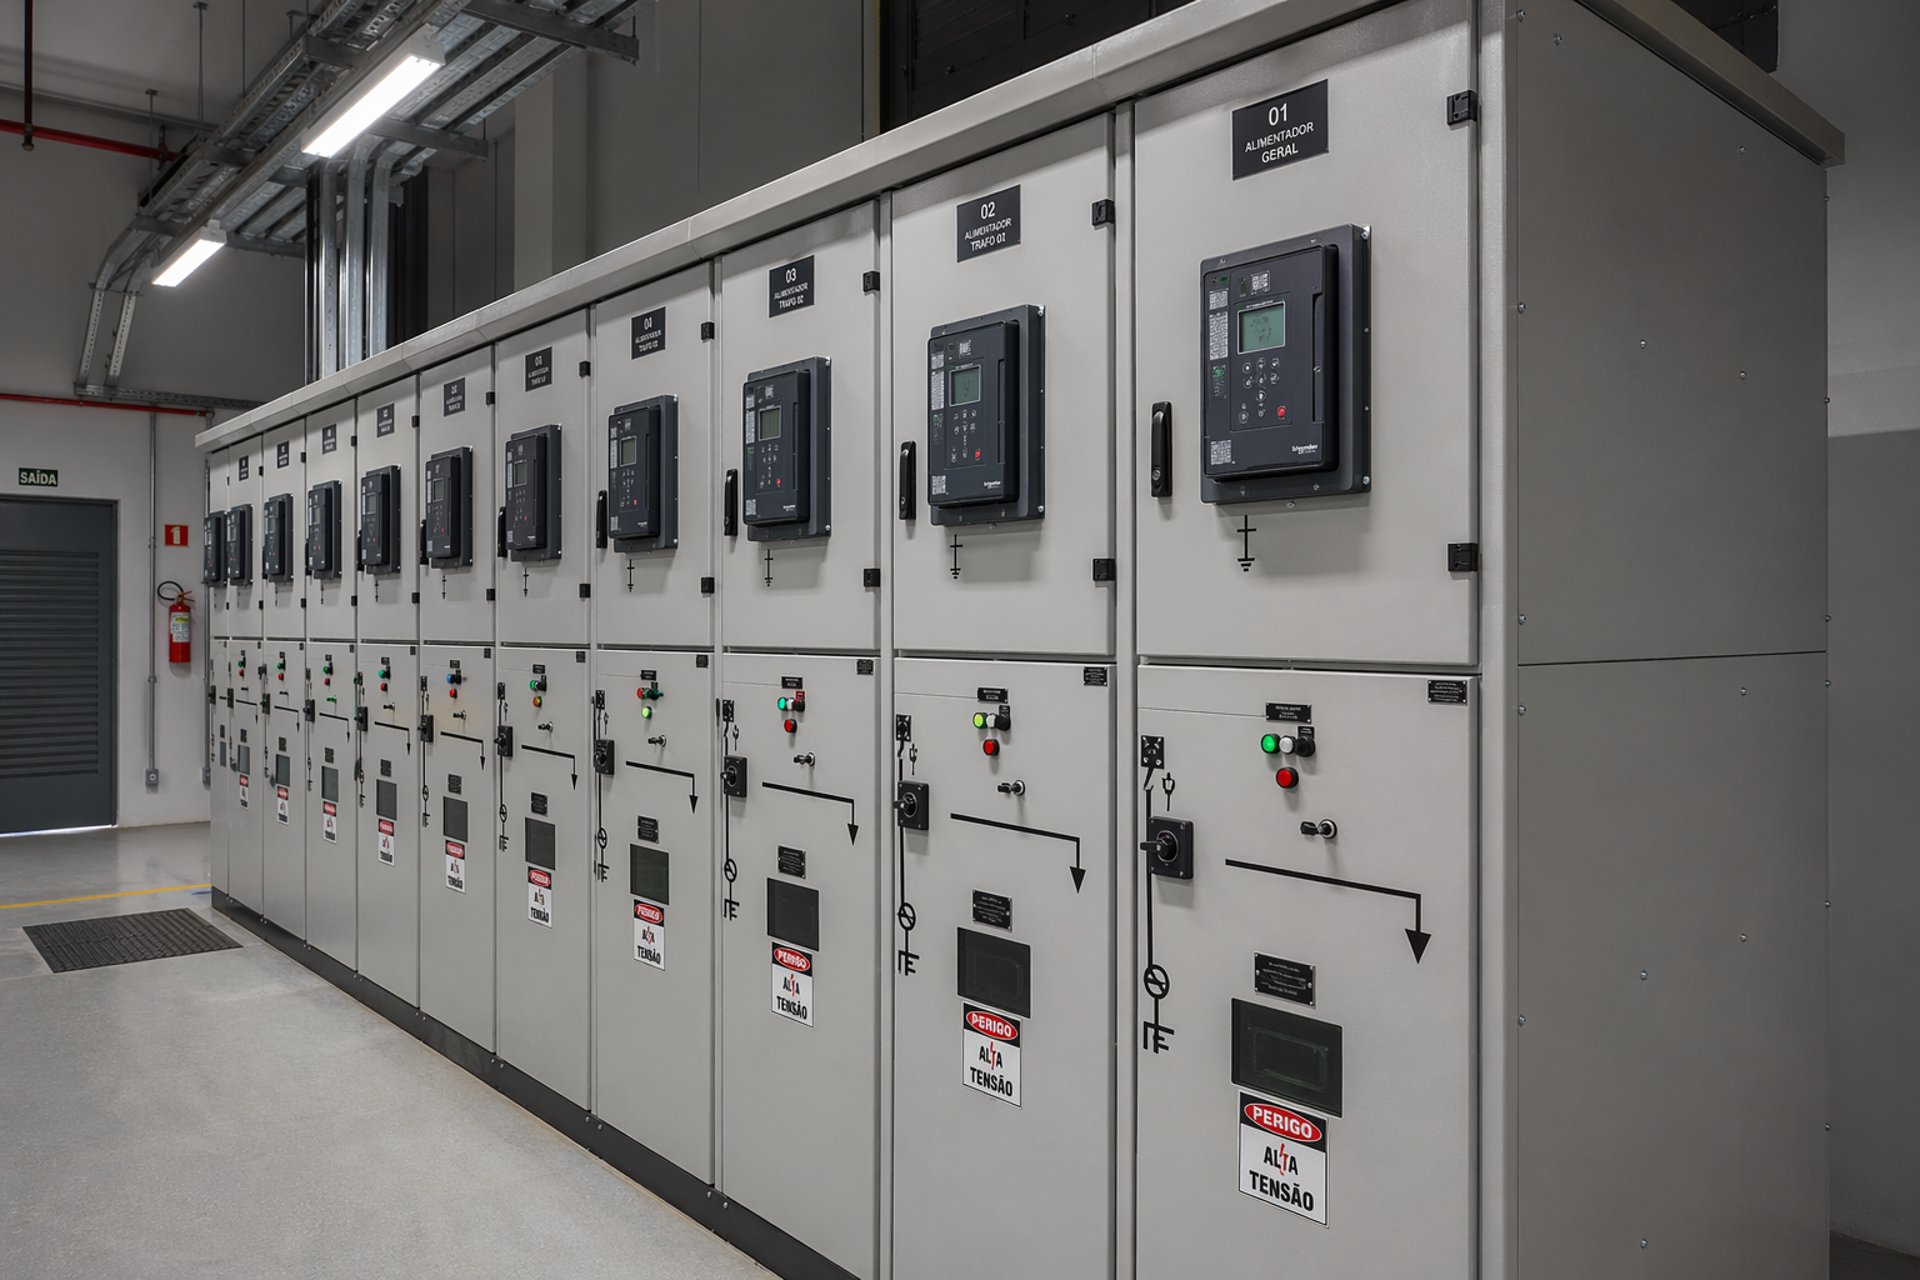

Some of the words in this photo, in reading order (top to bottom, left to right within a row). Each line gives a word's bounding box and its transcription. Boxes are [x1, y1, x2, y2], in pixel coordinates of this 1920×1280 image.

[1268, 102, 1288, 126] 01
[1244, 121, 1315, 153] ALIMENTADOR
[1261, 142, 1299, 164] GERAL
[980, 201, 996, 220] 02
[970, 233, 996, 252] TRAFO
[785, 267, 797, 284] 03
[20, 469, 58, 486] SAÍDA
[169, 526, 181, 545] 1
[971, 1012, 1014, 1039] PERIGO
[978, 1045, 1004, 1071] ALTA
[969, 1066, 1014, 1098] TENSÃO
[1252, 1105, 1313, 1140] PERIGO
[1262, 1145, 1299, 1176] ALTA
[1248, 1169, 1315, 1213] TENSÃO
